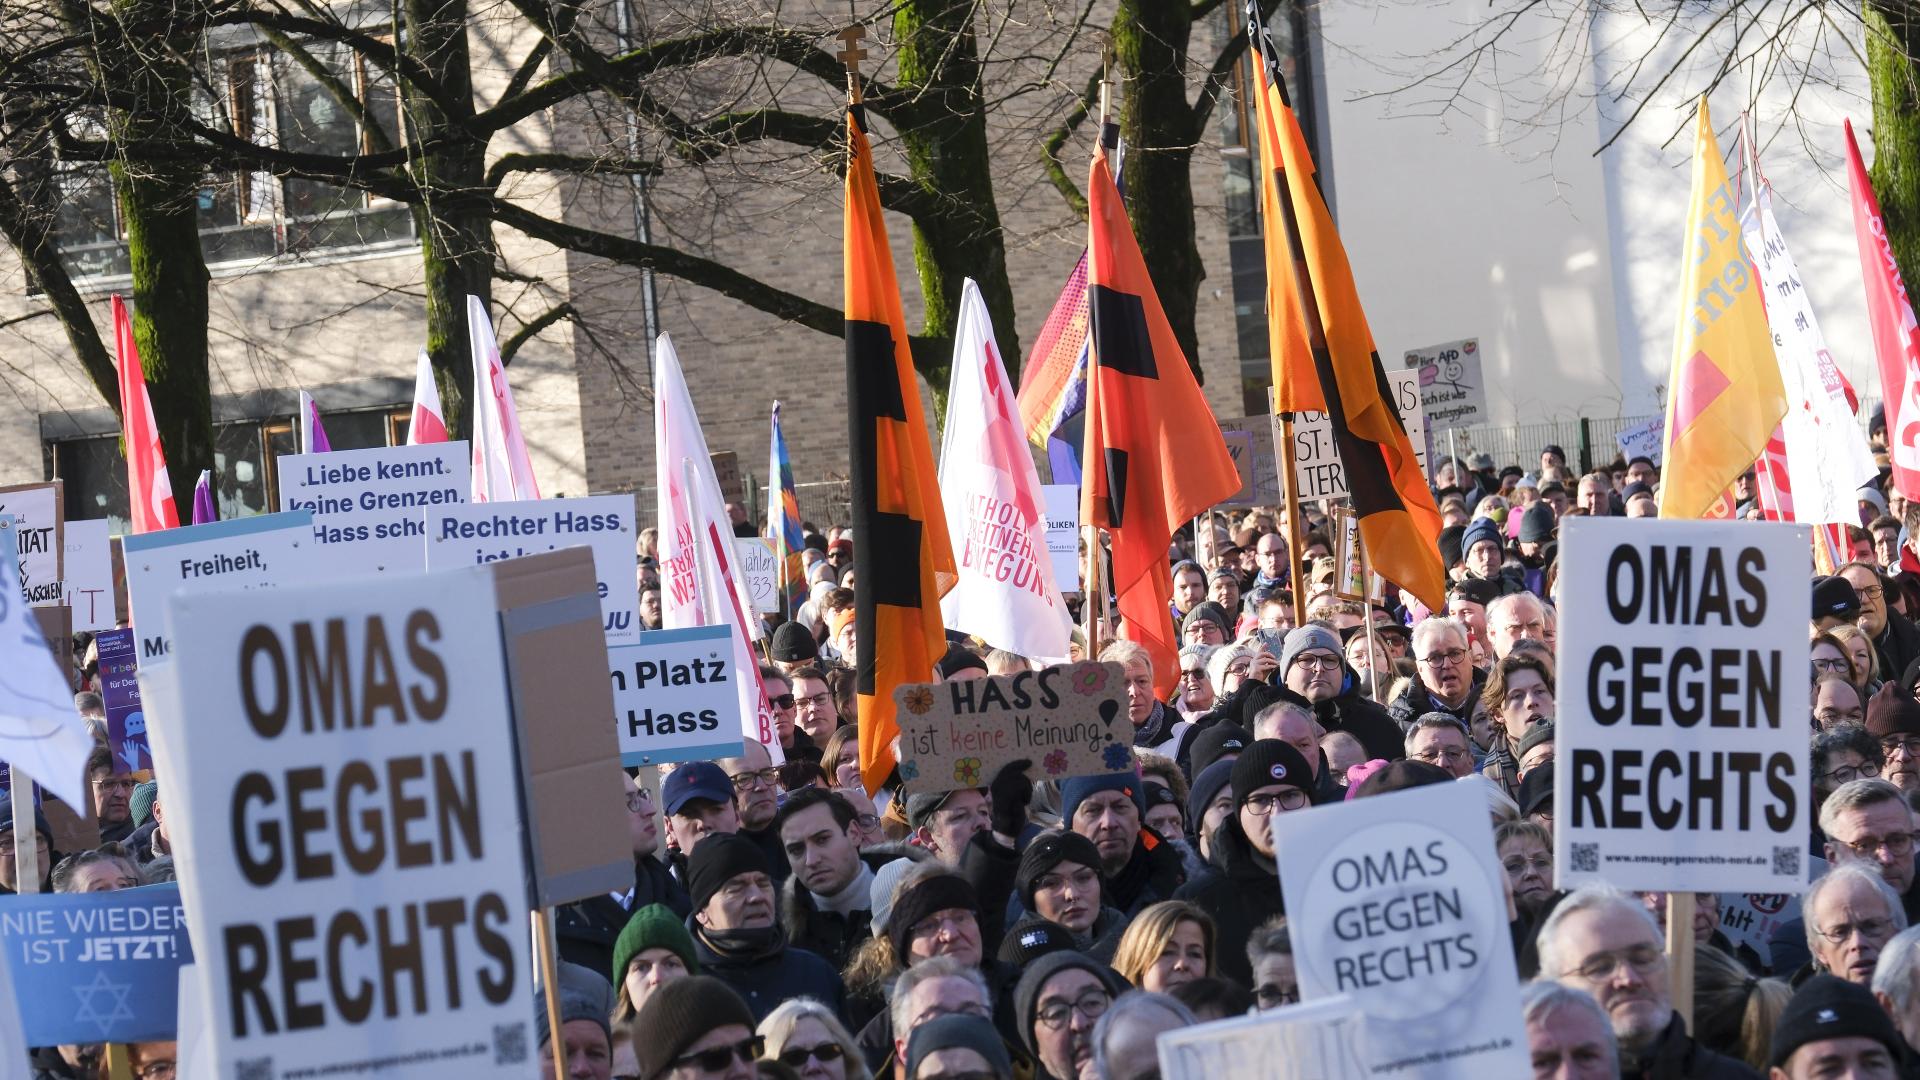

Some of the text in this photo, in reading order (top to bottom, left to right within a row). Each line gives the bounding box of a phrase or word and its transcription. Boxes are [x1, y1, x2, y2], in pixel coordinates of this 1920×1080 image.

[307, 457, 444, 486] Liebe kennt
[290, 487, 465, 516] keine Grenzen,
[314, 521, 369, 545] Hass
[441, 510, 621, 540] Rechter Hass
[180, 549, 267, 579] Freiheit,
[744, 545, 775, 573] ählen
[1606, 543, 1768, 628] OMAS
[604, 610, 631, 631] JU
[110, 680, 121, 689] für
[239, 607, 449, 740] OMAS
[636, 657, 727, 690] Platz
[1587, 644, 1782, 730] GEGEN
[951, 667, 1061, 716] HASS
[628, 708, 719, 737] Hass
[911, 724, 939, 756] ist
[951, 719, 1008, 752] keine
[1571, 748, 1797, 834] RECHTS
[231, 749, 485, 889] GEGEN
[1332, 840, 1449, 894] OMAS
[2, 904, 188, 937] NIE WIEDER
[1333, 887, 1463, 942] GEGEN
[23, 936, 178, 965] IST JETZT!
[223, 891, 516, 1040] RECHTS
[1334, 932, 1479, 992] RECHTS
